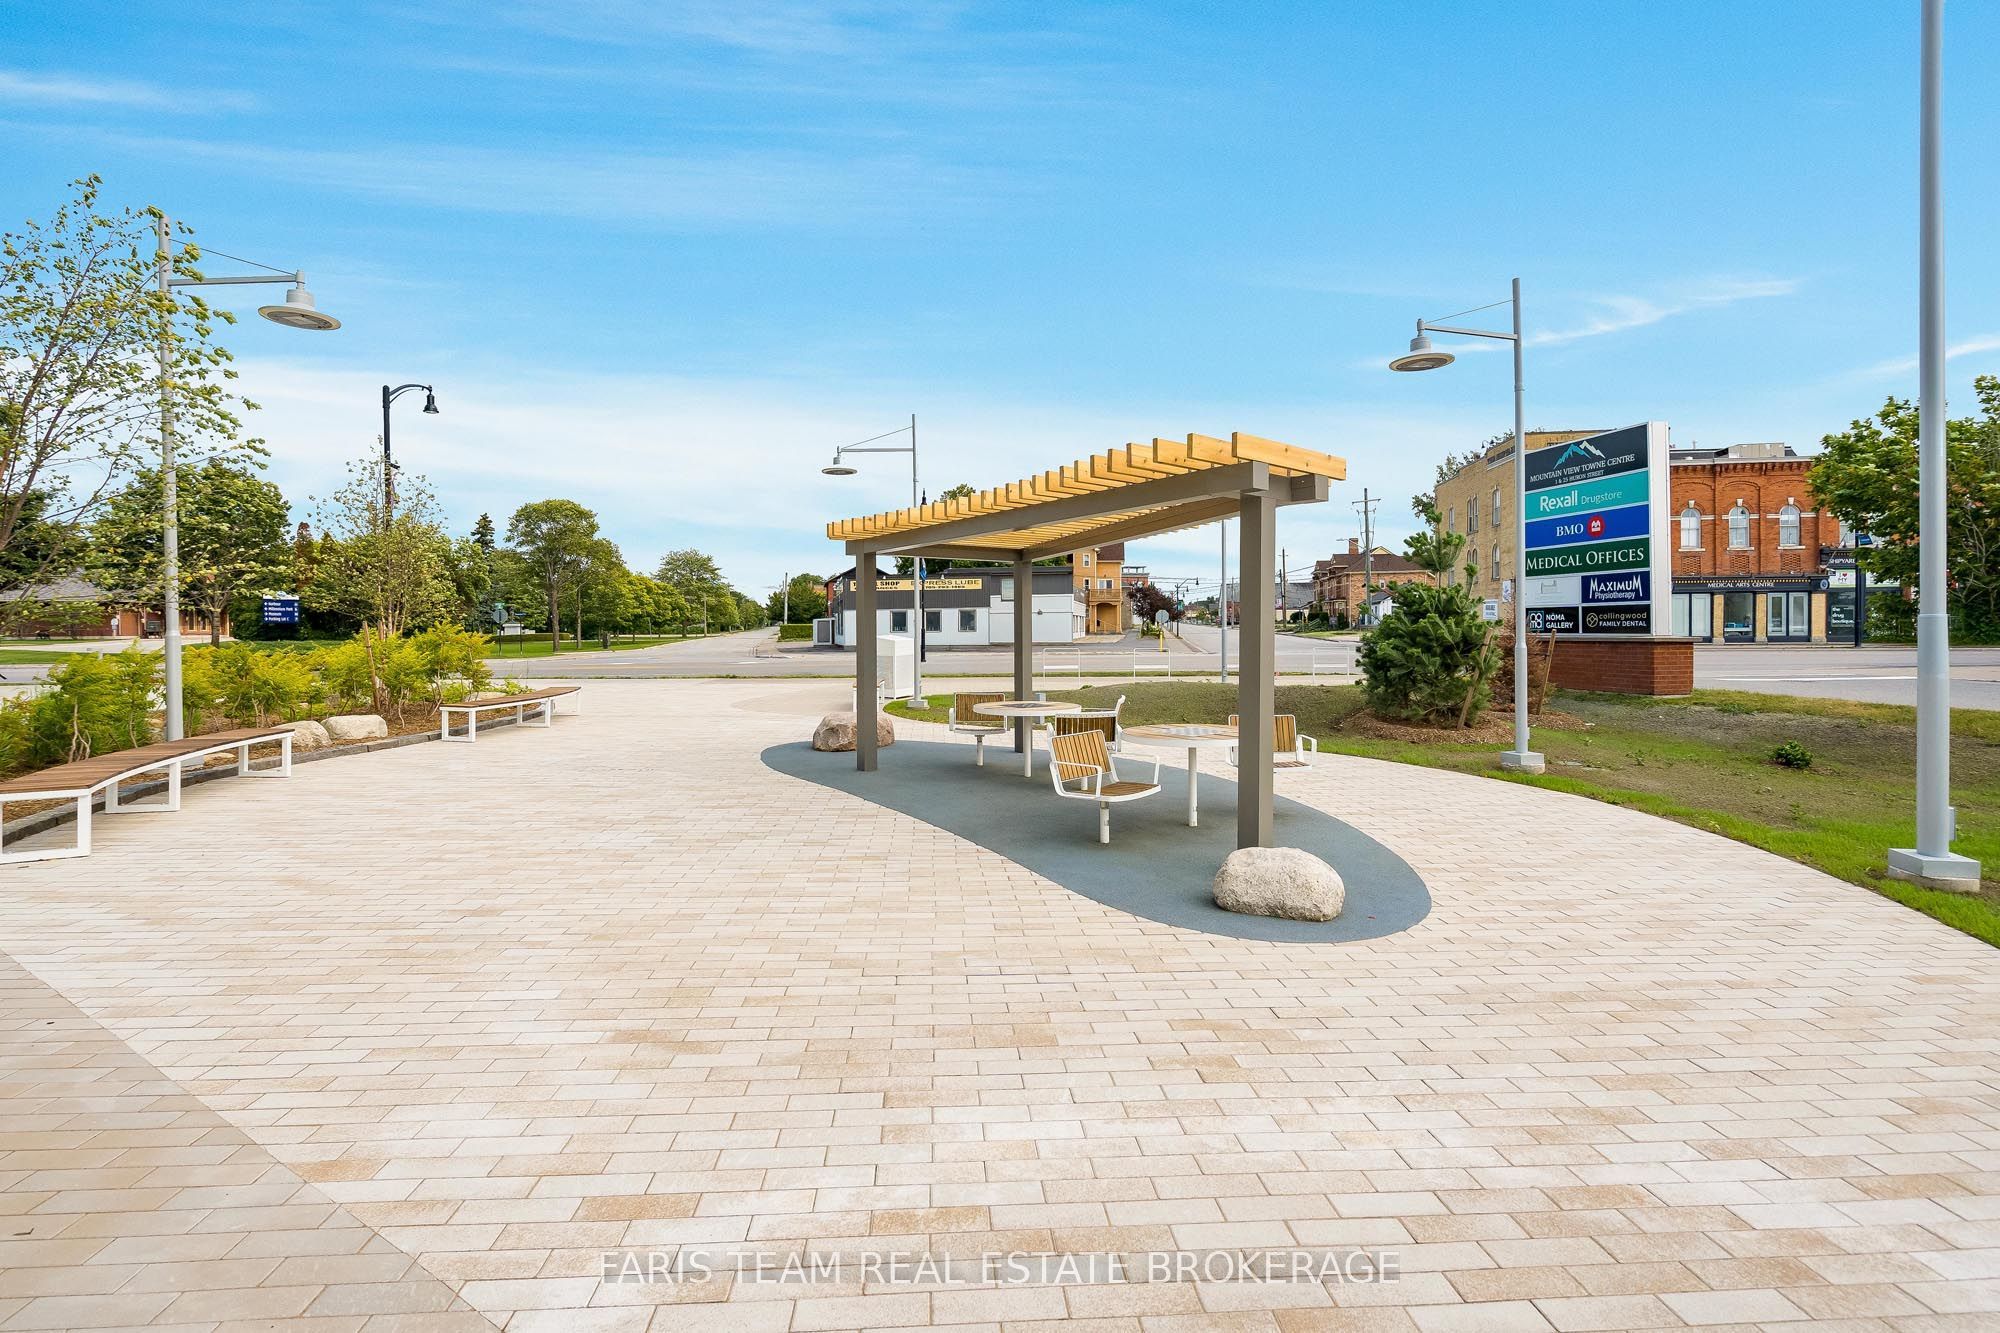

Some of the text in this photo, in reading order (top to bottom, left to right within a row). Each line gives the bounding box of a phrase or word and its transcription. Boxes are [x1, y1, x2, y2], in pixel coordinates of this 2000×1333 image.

[1529, 453, 1636, 483] MOUNTAIN VIEW TOWNE CENTRE
[1569, 474, 1587, 482] HURON
[1586, 469, 1605, 479] STREET
[1540, 489, 1623, 512] Rexall Drugstore
[1556, 523, 1584, 537] BMO
[1526, 547, 1645, 571] MEDICAL OFFICES
[1590, 574, 1643, 599] MAXIMUM
[1595, 591, 1636, 601] Physiotherapy
[1598, 611, 1647, 621] collingwood
[1545, 621, 1574, 629] GALLERY
